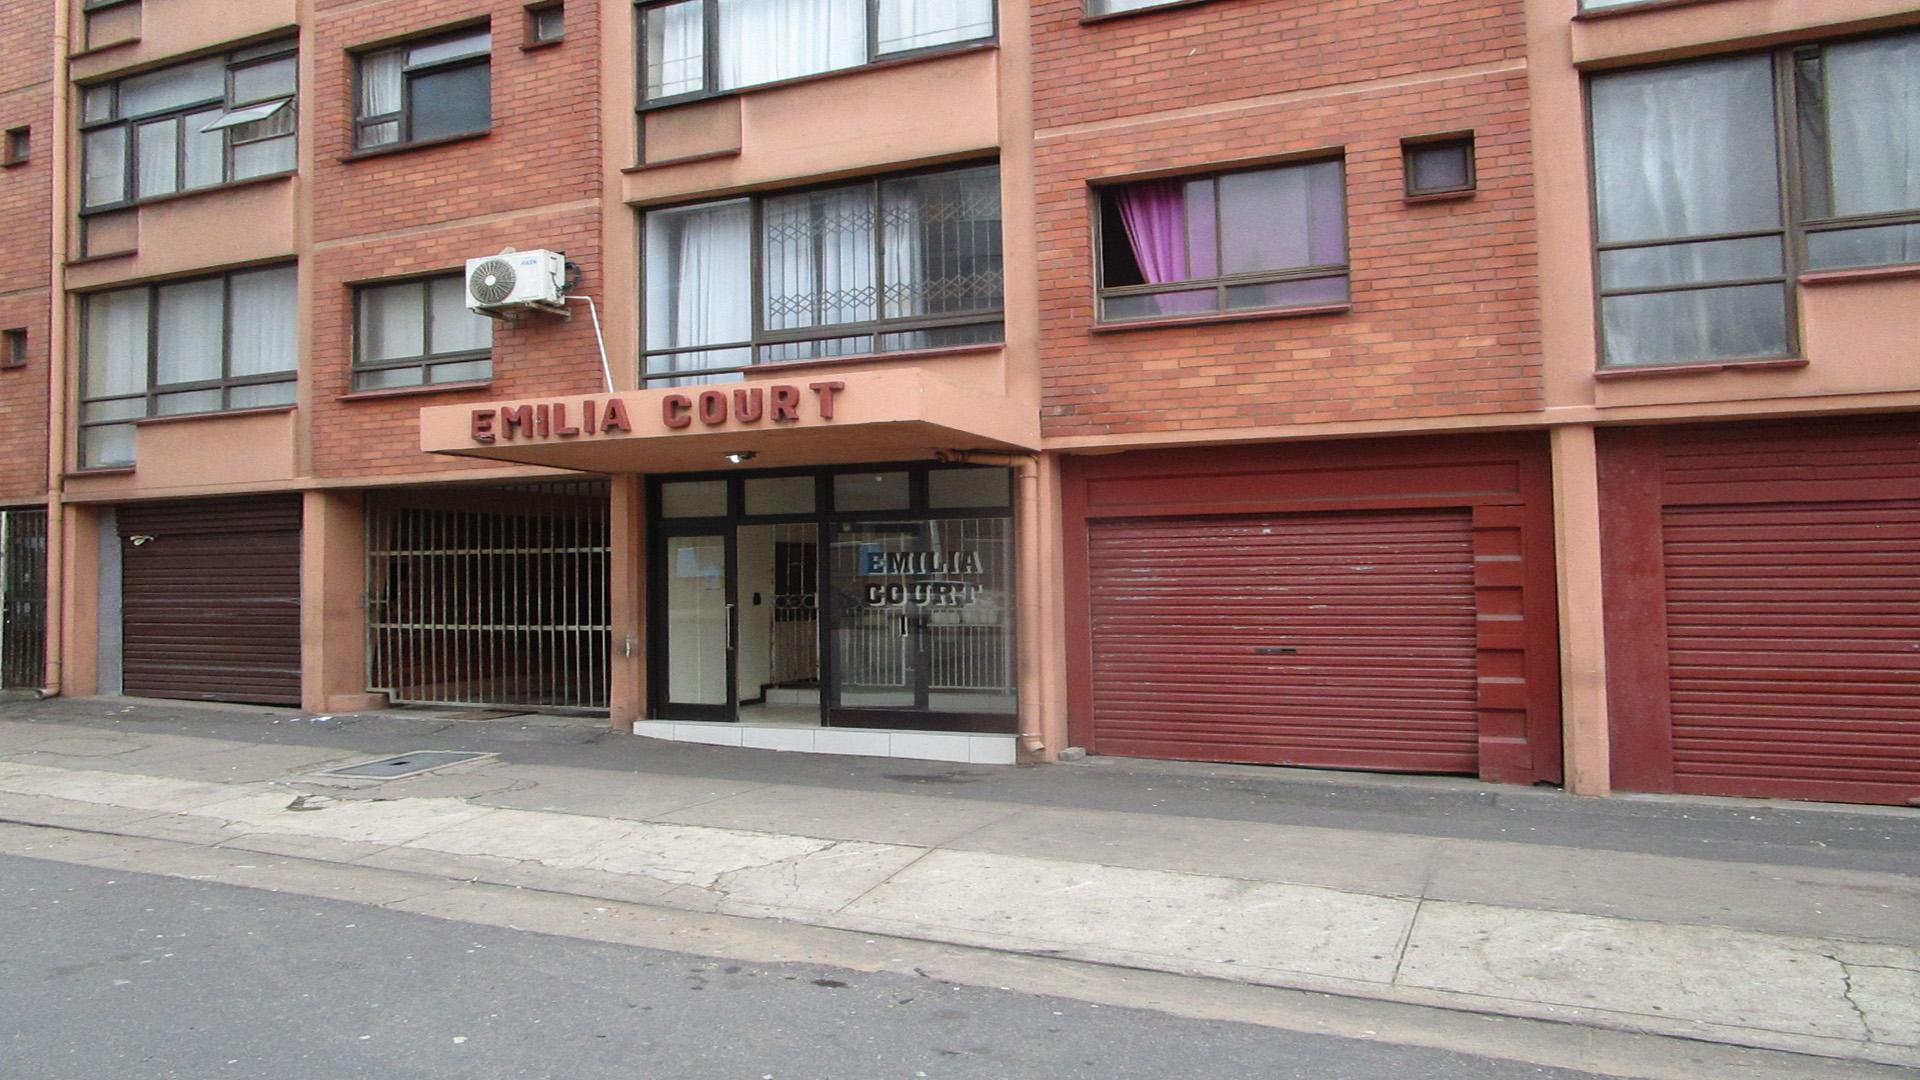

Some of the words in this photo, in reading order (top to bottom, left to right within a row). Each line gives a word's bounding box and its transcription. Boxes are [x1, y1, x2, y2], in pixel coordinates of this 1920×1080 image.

[471, 398, 632, 443] EMILIA
[662, 381, 846, 429] COURT
[867, 551, 984, 575] EMILIA
[865, 583, 983, 607] COURT
